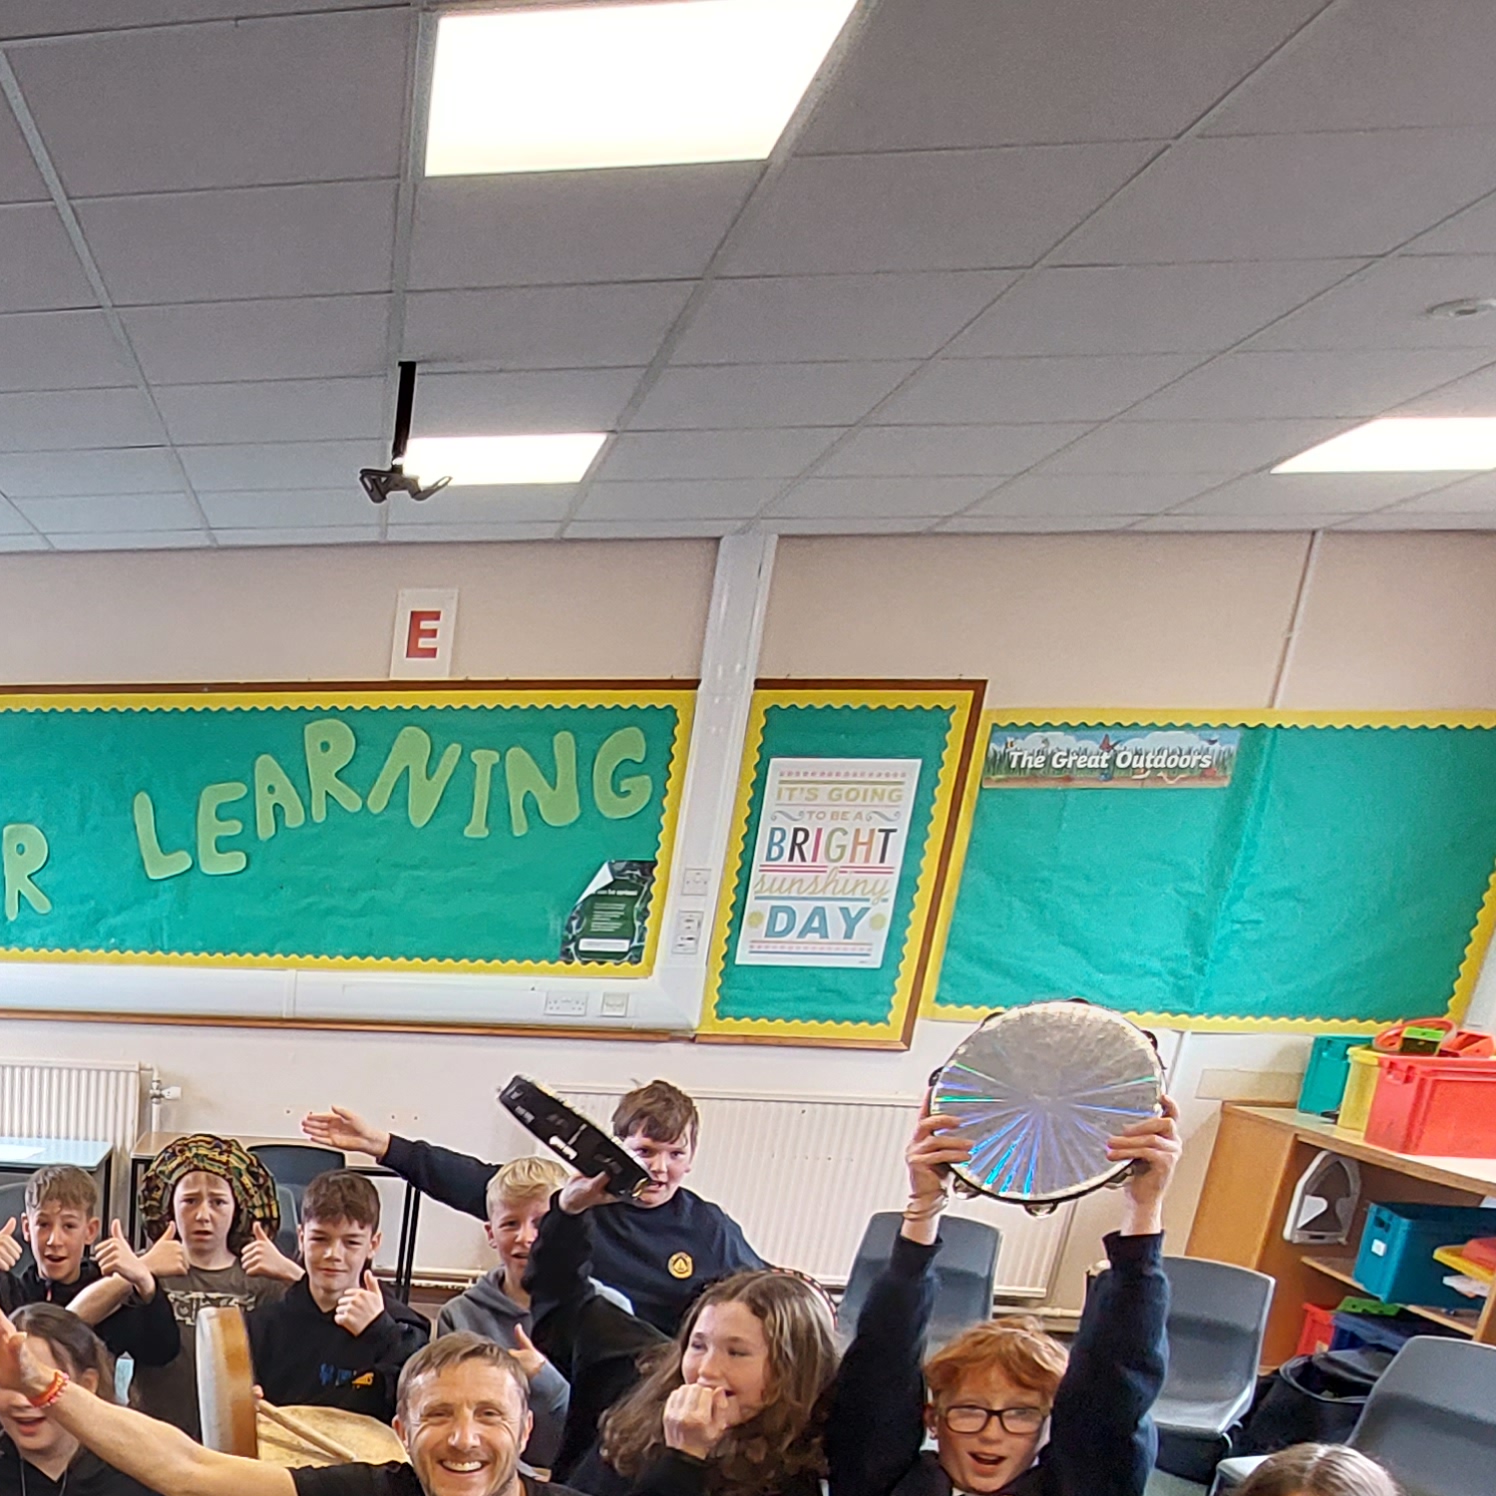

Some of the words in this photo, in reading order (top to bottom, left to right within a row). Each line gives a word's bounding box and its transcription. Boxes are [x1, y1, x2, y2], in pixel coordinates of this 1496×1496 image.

[406, 610, 441, 658] E
[1008, 750, 1046, 770] The
[1051, 750, 1110, 770] Great
[1115, 750, 1213, 770] Outdoors
[132, 717, 653, 881] LEARNING
[775, 786, 819, 802] IT'S
[827, 786, 904, 803] GOING
[806, 810, 825, 821] TO
[830, 810, 851, 821] BE
[852, 810, 864, 821] A
[765, 826, 897, 864] BRIGHT
[753, 866, 890, 906] sunshiny
[764, 905, 871, 940] DAY
